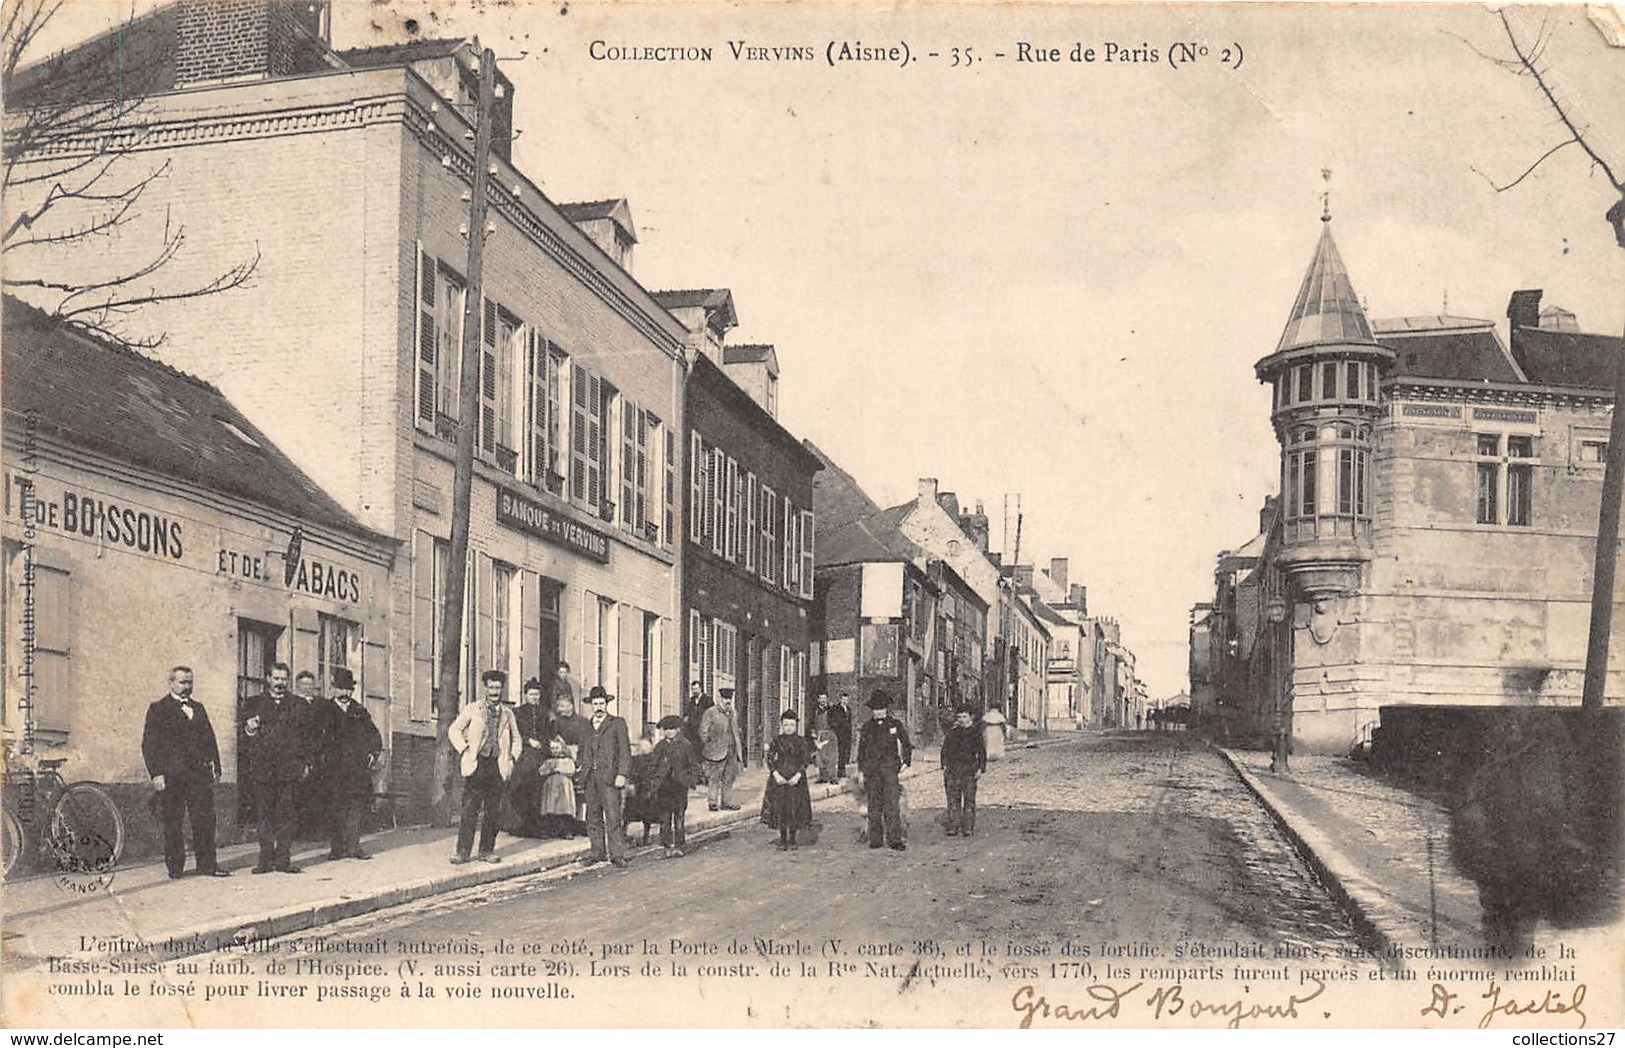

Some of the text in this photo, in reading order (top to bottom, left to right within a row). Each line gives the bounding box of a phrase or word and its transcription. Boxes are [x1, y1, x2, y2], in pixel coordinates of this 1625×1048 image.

[36, 499, 58, 528] DE
[64, 491, 183, 559] BOISSONS
[502, 494, 549, 531] BANQUE
[562, 521, 606, 556] VERVINS
[219, 550, 359, 603] ET DE ABACS
